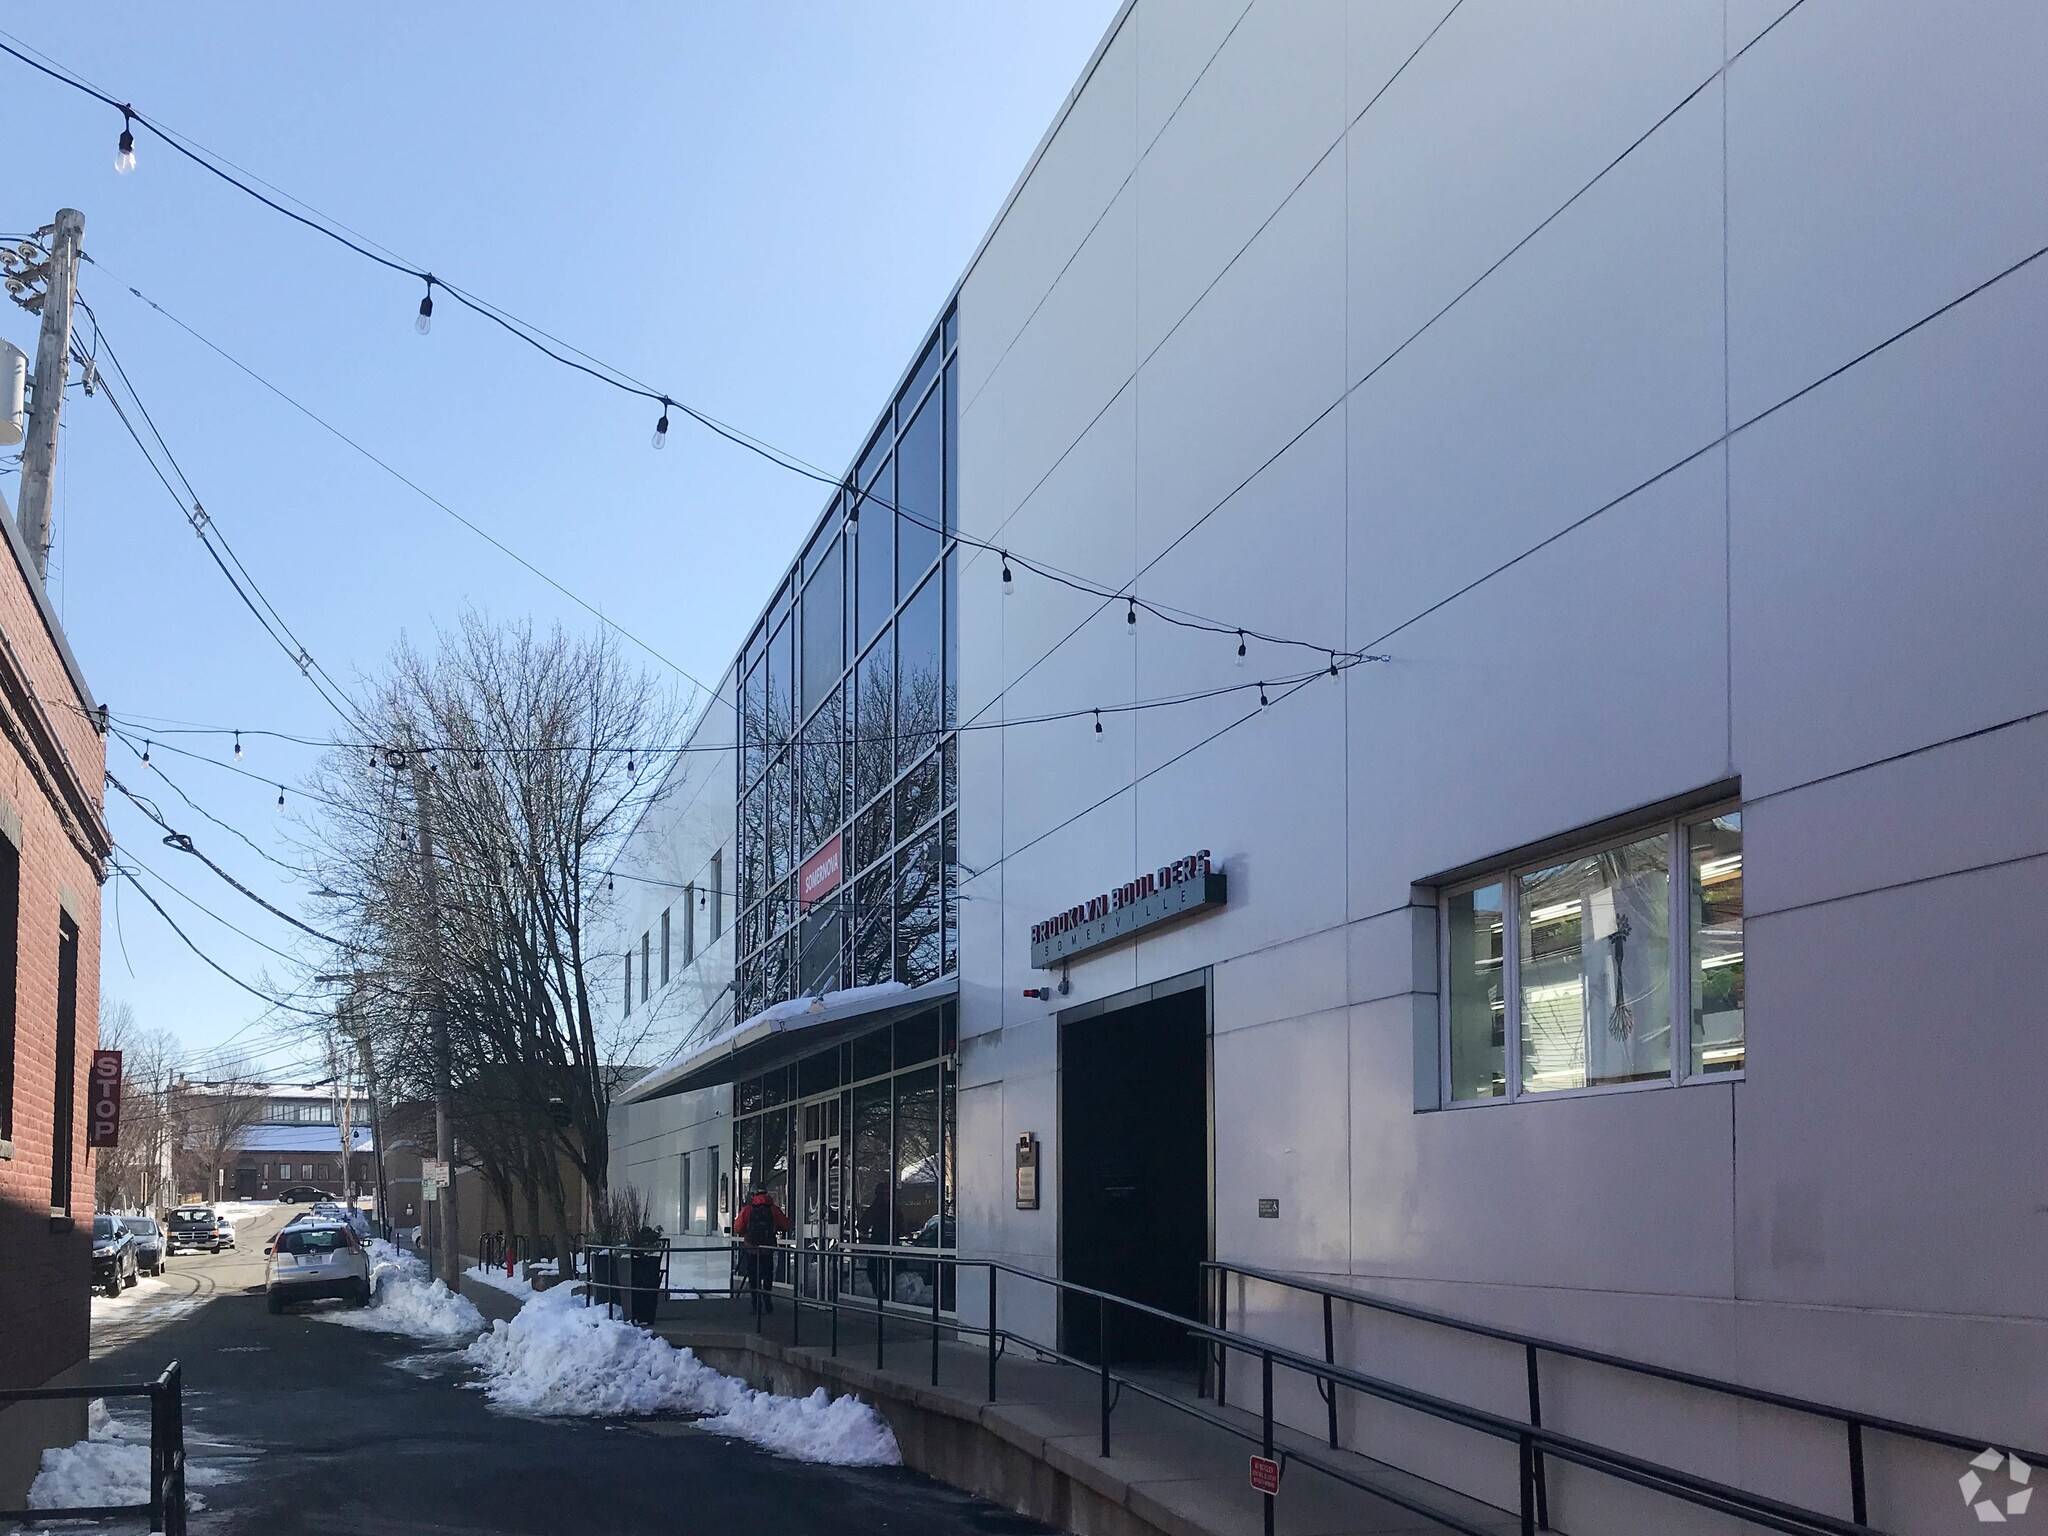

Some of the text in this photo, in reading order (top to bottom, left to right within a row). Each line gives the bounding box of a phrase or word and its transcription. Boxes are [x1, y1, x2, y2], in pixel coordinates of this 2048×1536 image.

[1031, 849, 1211, 945] BROOKLYN BOULDERS
[1044, 889, 1187, 957] SOMERVILLE
[95, 1056, 119, 1141] STOP
